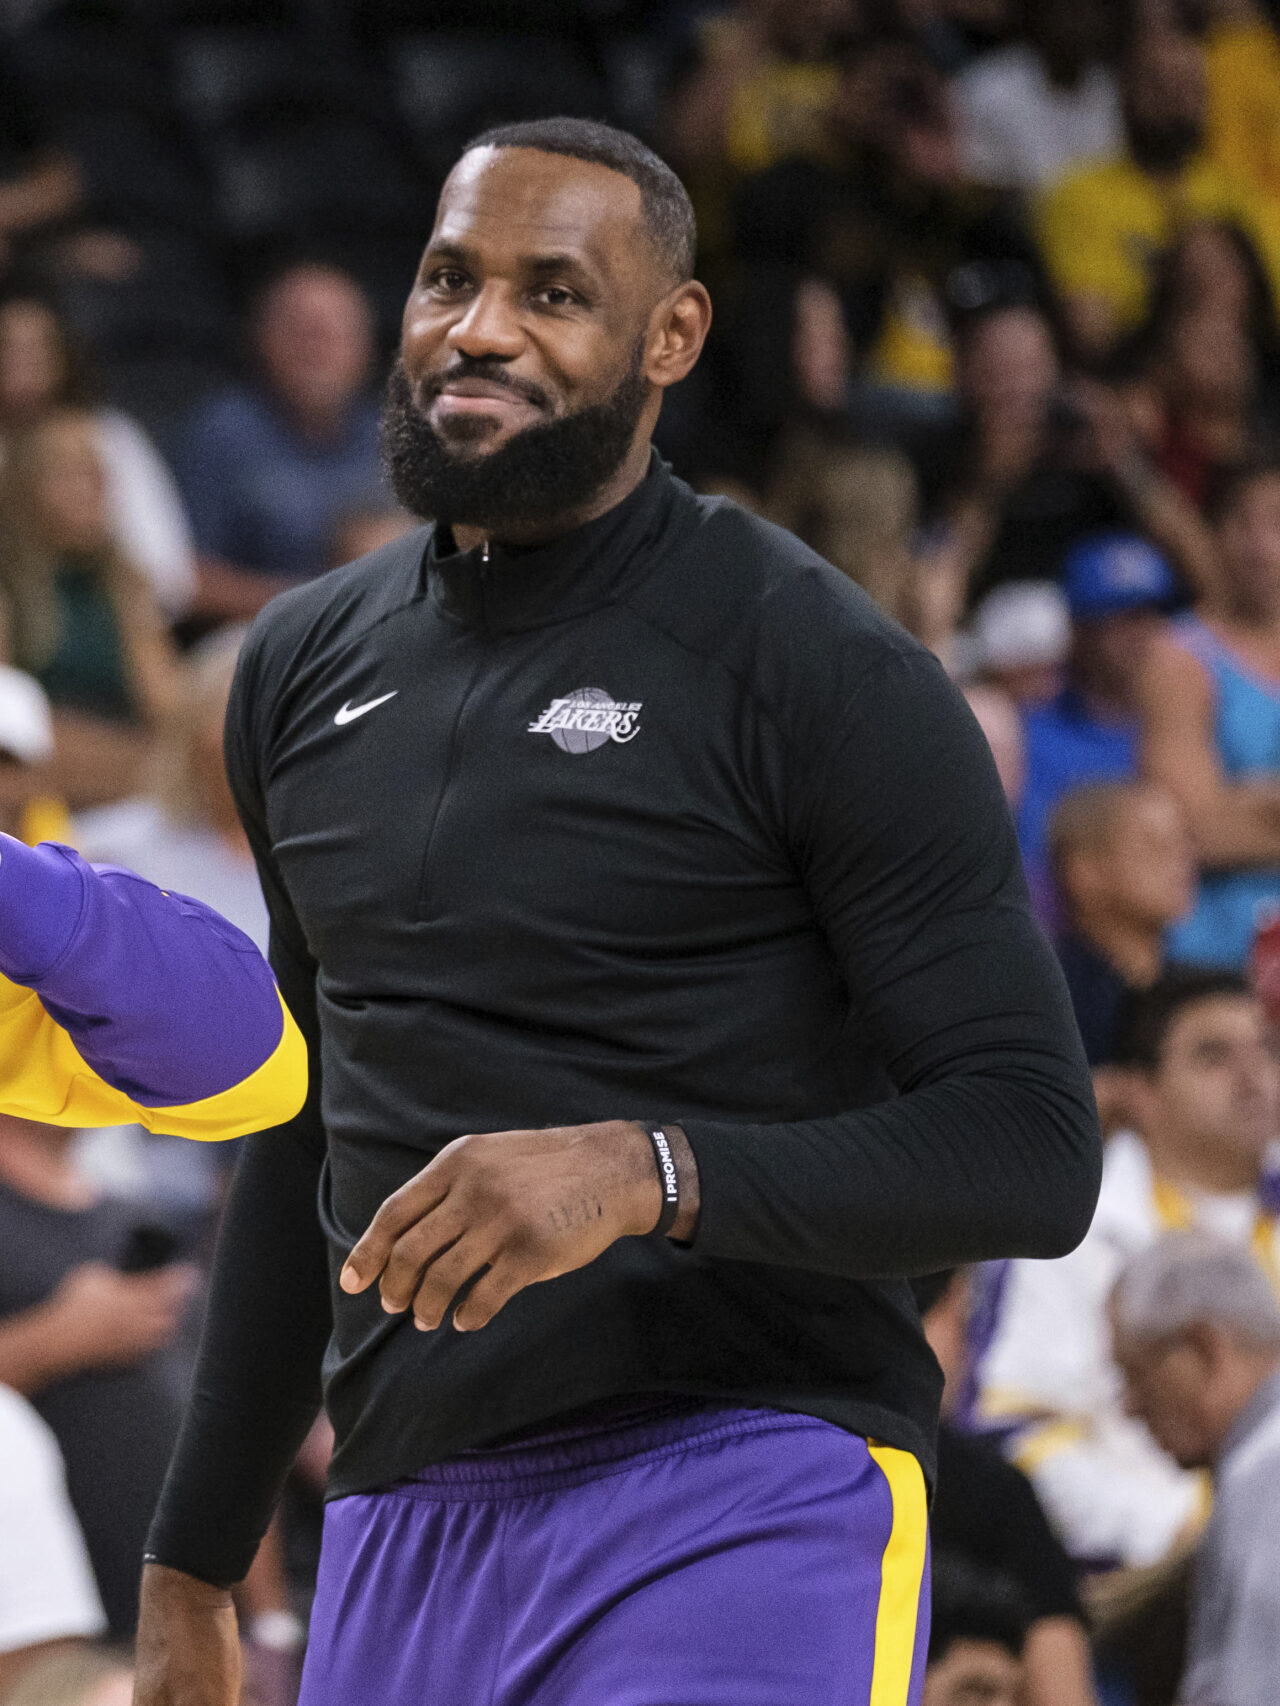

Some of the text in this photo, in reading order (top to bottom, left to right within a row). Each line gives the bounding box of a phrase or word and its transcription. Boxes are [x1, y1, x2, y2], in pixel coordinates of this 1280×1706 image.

[528, 699, 640, 743] LAKERS
[570, 701, 642, 711] LOS ANGELES
[653, 1132, 677, 1193] PROMISE
